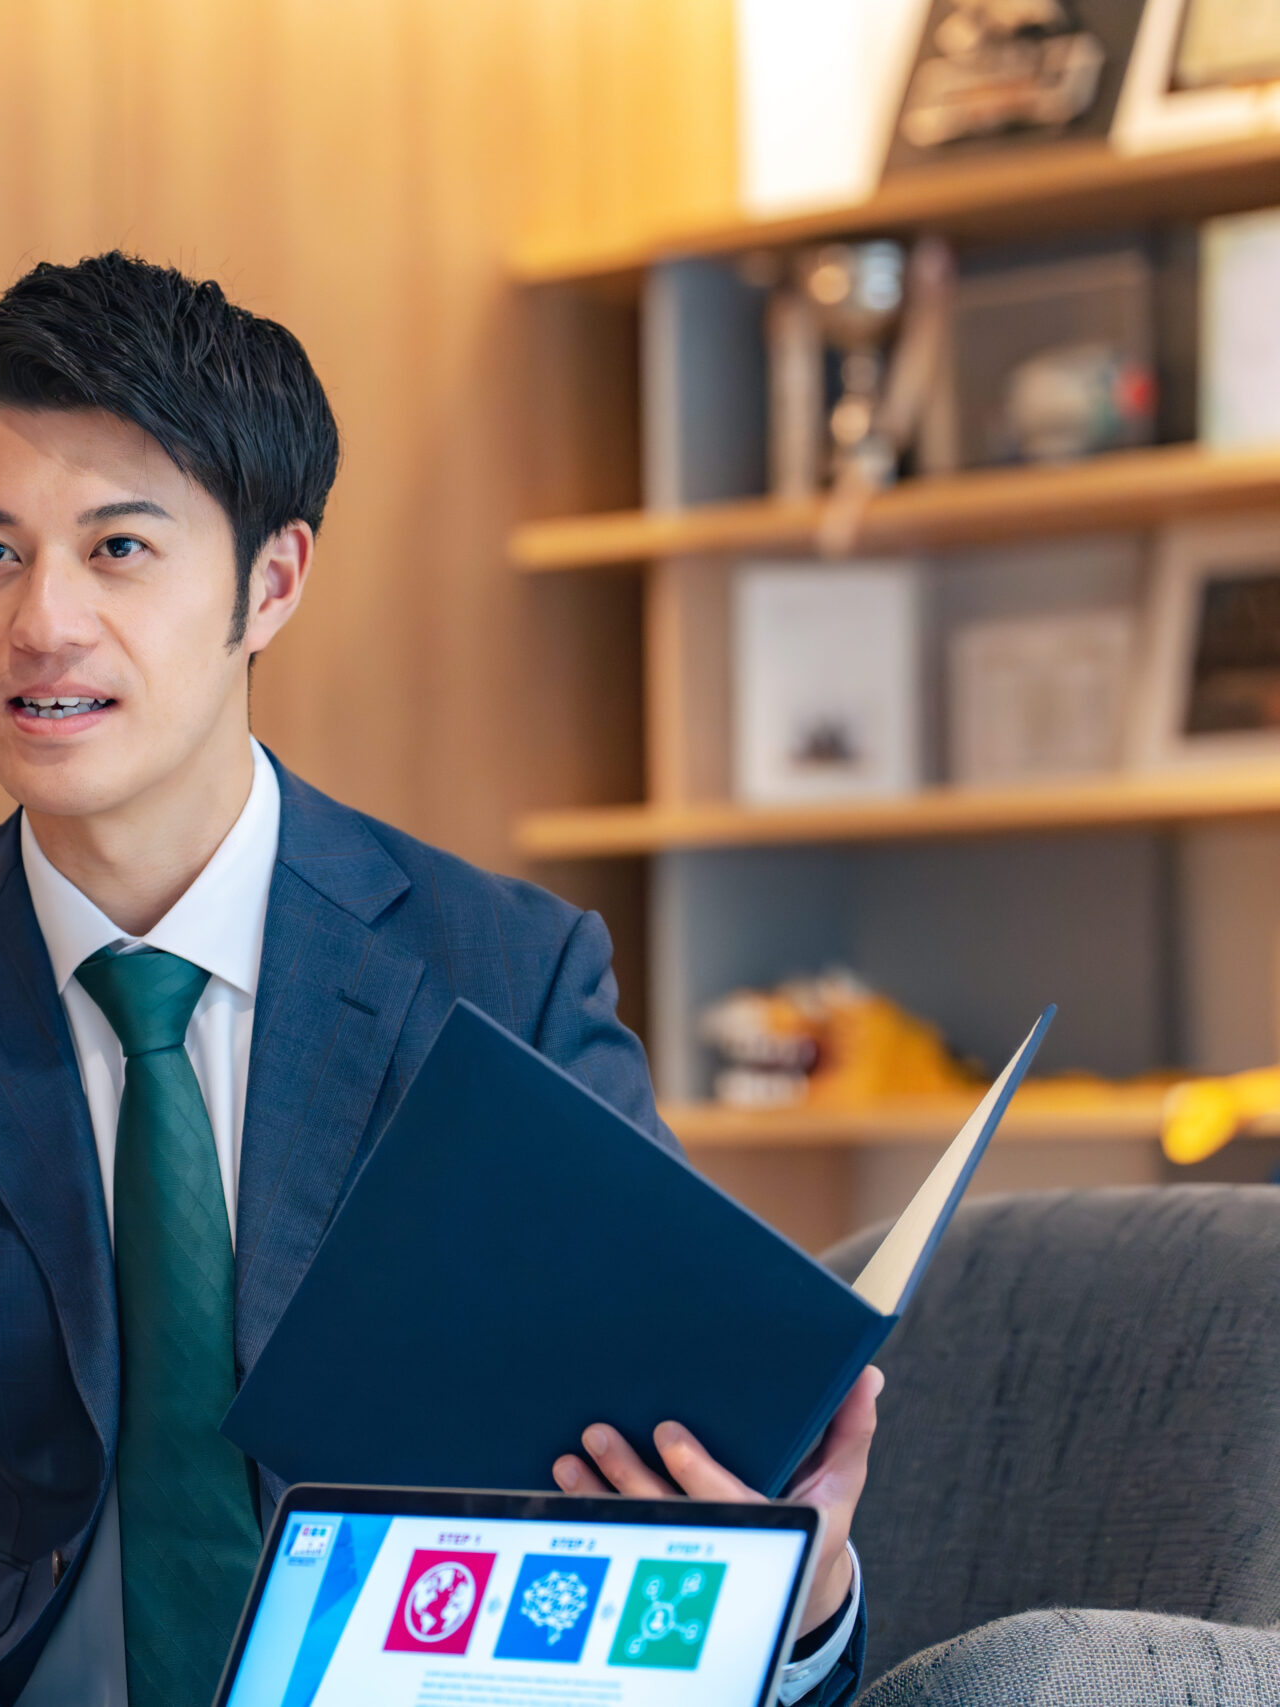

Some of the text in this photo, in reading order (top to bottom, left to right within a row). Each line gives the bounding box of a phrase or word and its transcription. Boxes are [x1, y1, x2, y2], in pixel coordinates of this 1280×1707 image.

[438, 1532, 471, 1545] STEP
[550, 1537, 582, 1550] STEP
[667, 1542, 700, 1555] STEP
